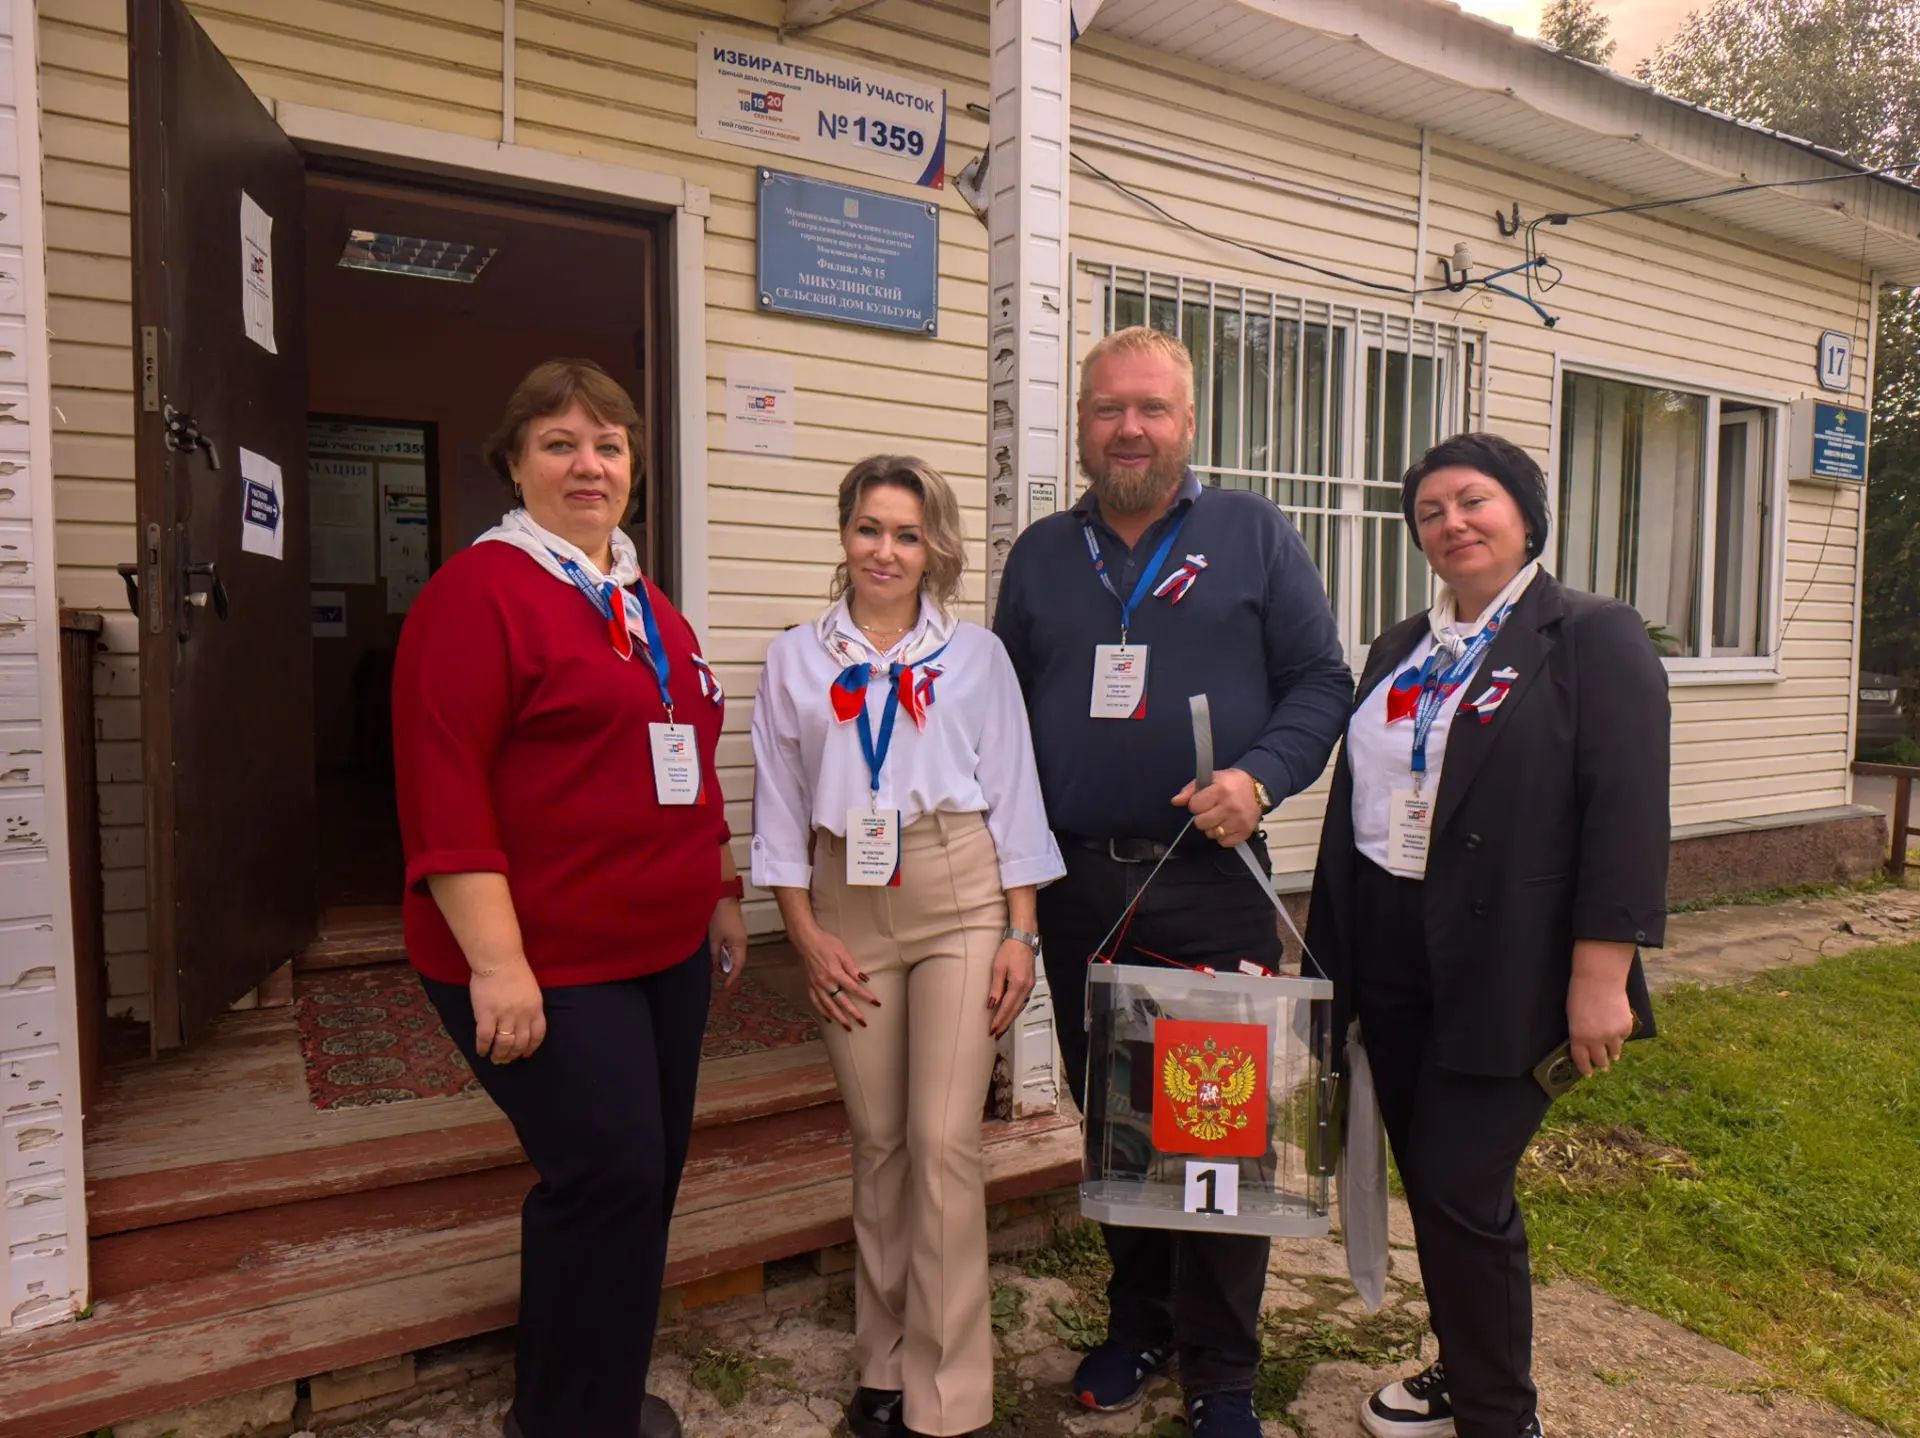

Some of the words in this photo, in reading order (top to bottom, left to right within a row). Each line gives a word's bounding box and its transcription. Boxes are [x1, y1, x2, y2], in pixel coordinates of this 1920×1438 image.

[713, 47, 862, 94] ИЗБИРАТЕЛЬНЫЙ
[866, 83, 935, 114] УЧАСТОК
[739, 100, 751, 112] 18
[752, 97, 766, 109] 19
[767, 95, 782, 108] 20
[817, 258, 858, 275] Филиал
[798, 272, 902, 301] МИКУЛИНСКИЙ
[775, 287, 837, 307] СЕЛЬСКИЙ
[838, 298, 864, 311] ДОМ
[866, 301, 922, 320] КУЛЬТУРЫ
[1828, 346, 1846, 376] 17
[1195, 1169, 1224, 1214] 1
